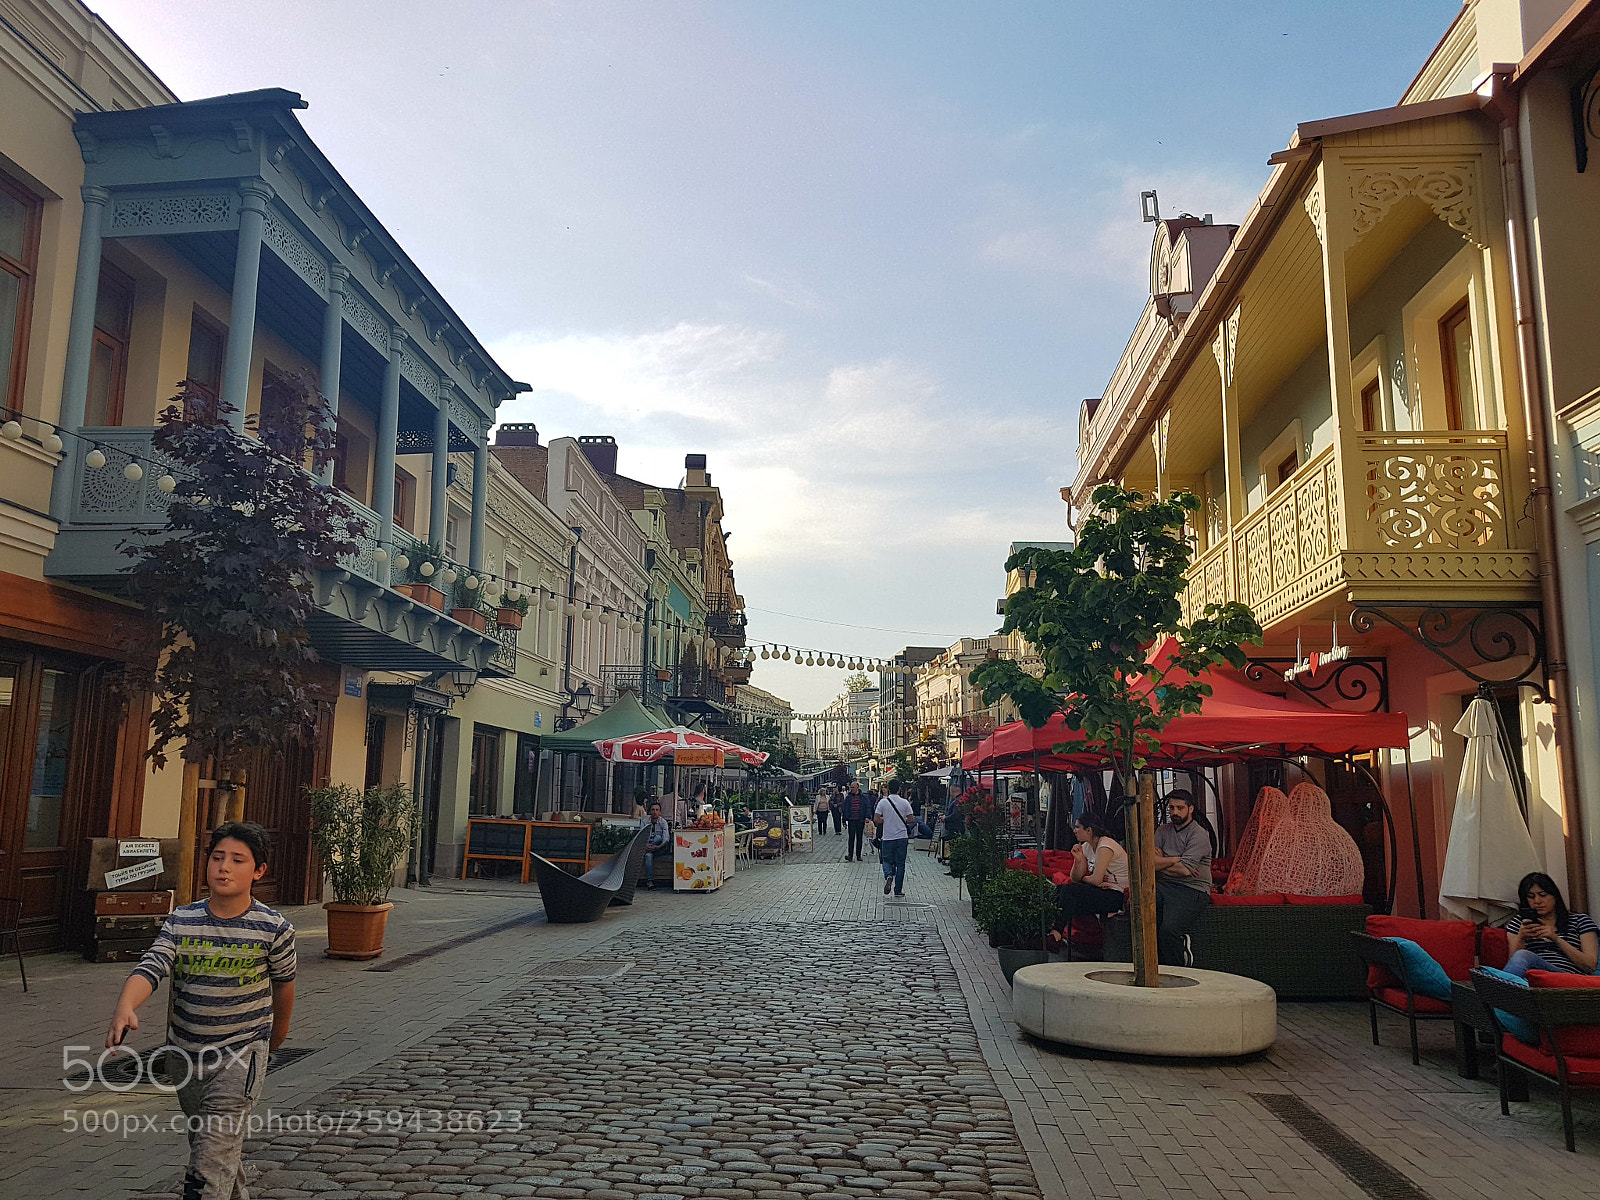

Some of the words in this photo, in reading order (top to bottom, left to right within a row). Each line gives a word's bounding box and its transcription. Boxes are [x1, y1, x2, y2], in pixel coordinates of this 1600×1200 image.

[181, 937, 213, 949] NEW
[223, 942, 262, 954] YORK
[177, 951, 255, 982] Vintage
